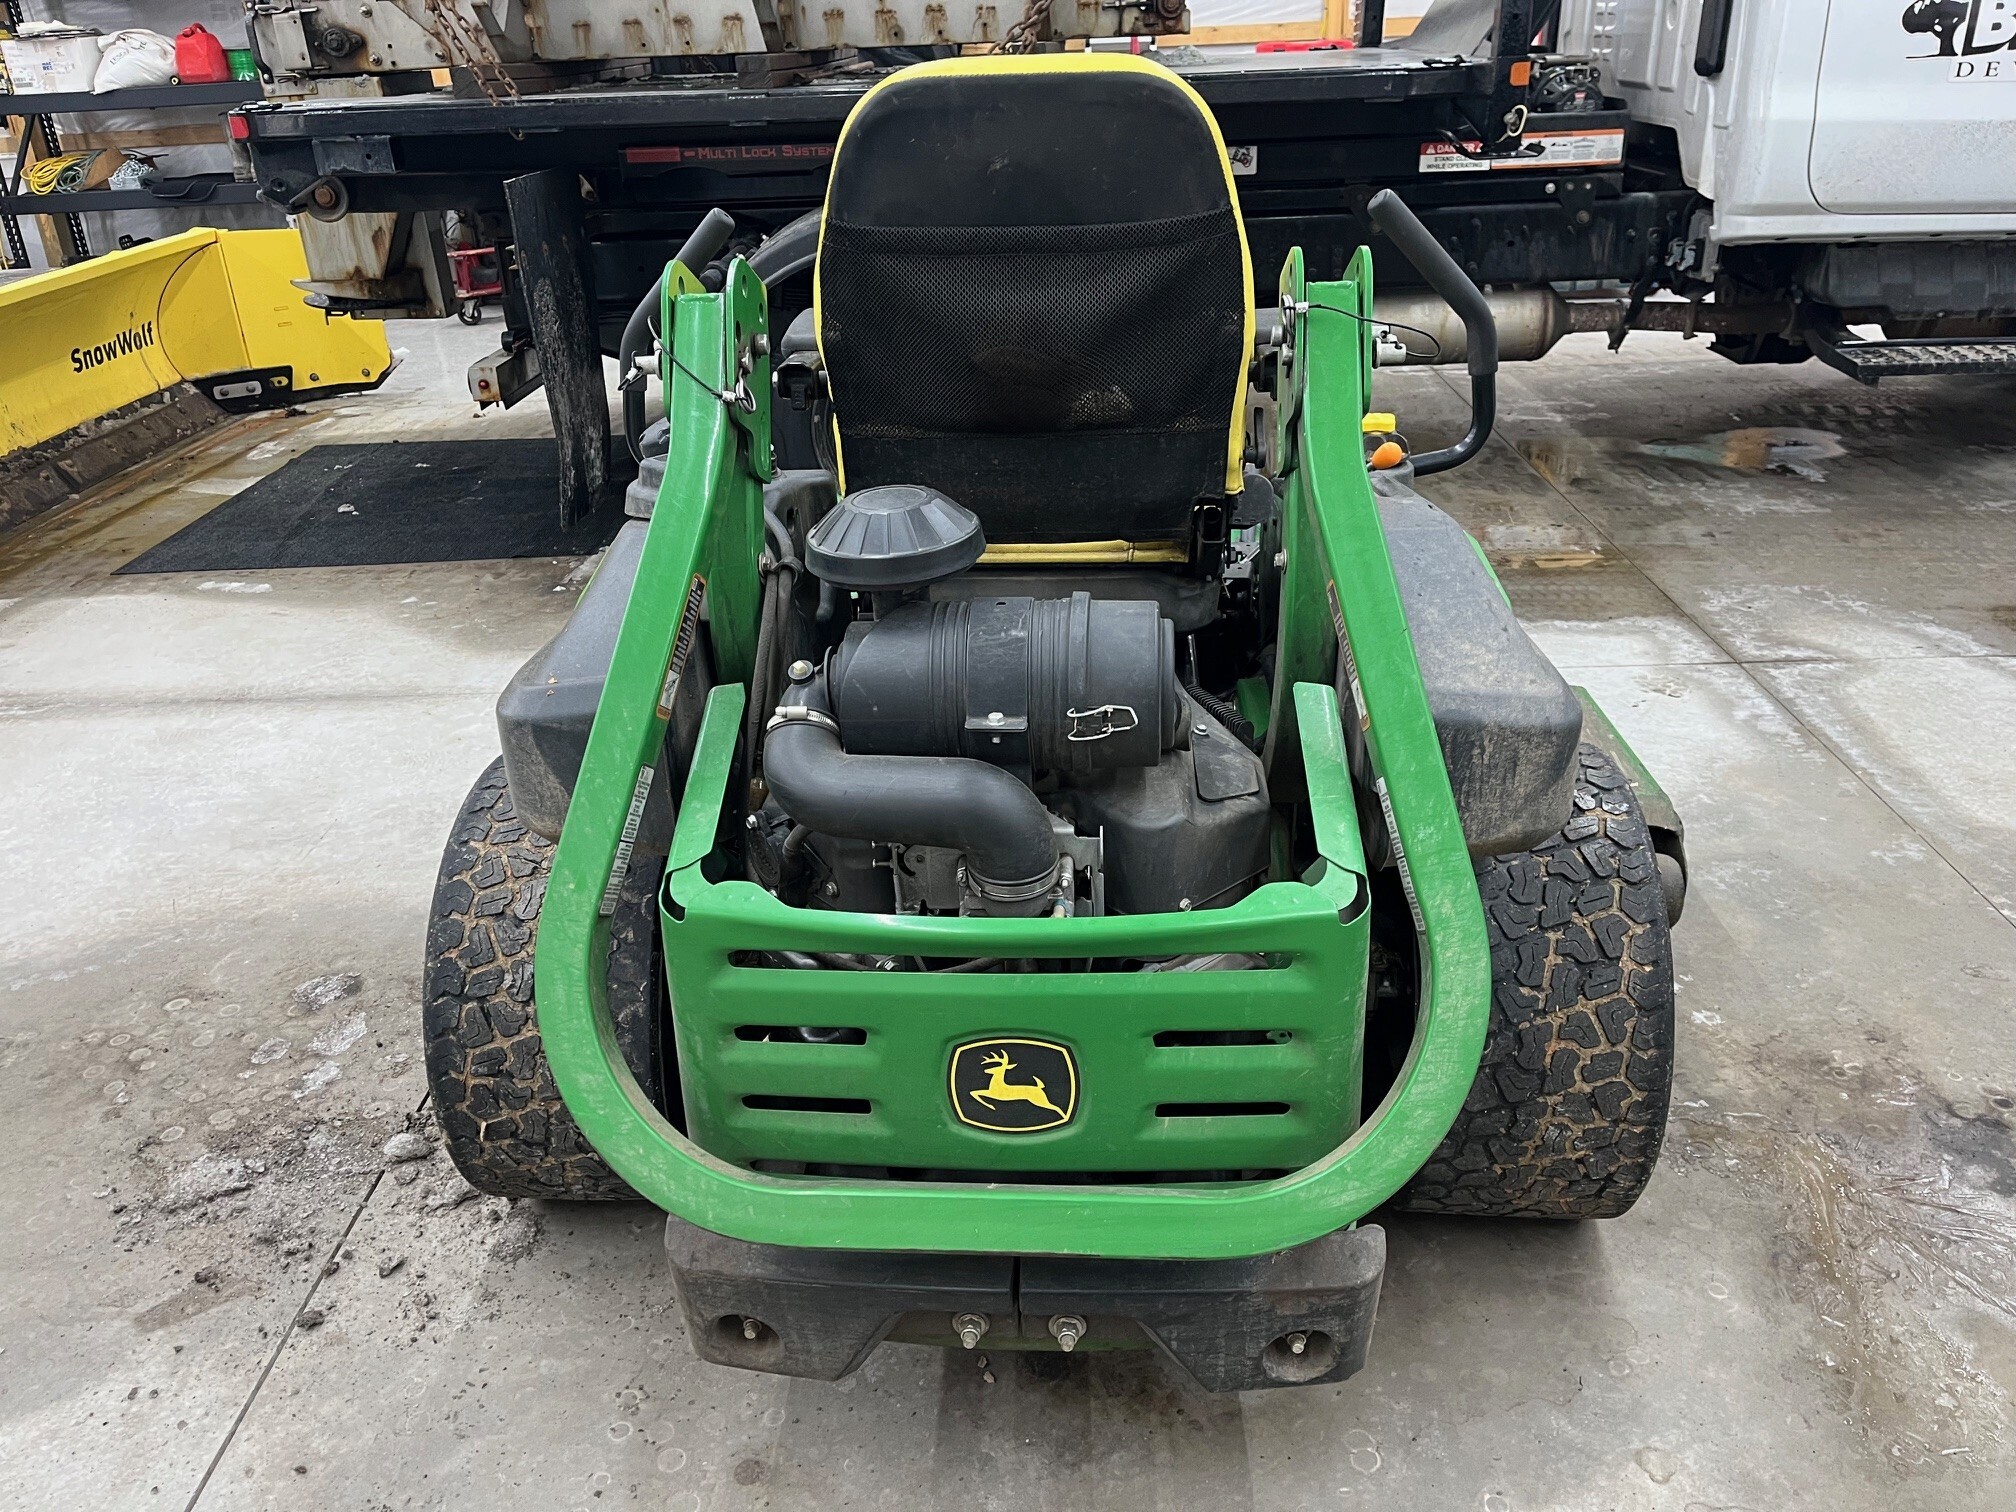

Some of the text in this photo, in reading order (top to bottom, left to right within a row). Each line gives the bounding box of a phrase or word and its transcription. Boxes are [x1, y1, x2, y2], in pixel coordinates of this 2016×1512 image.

[1954, 61, 2016, 77] DE
[741, 145, 776, 158] LOCK
[70, 320, 154, 373] SnowWolf
